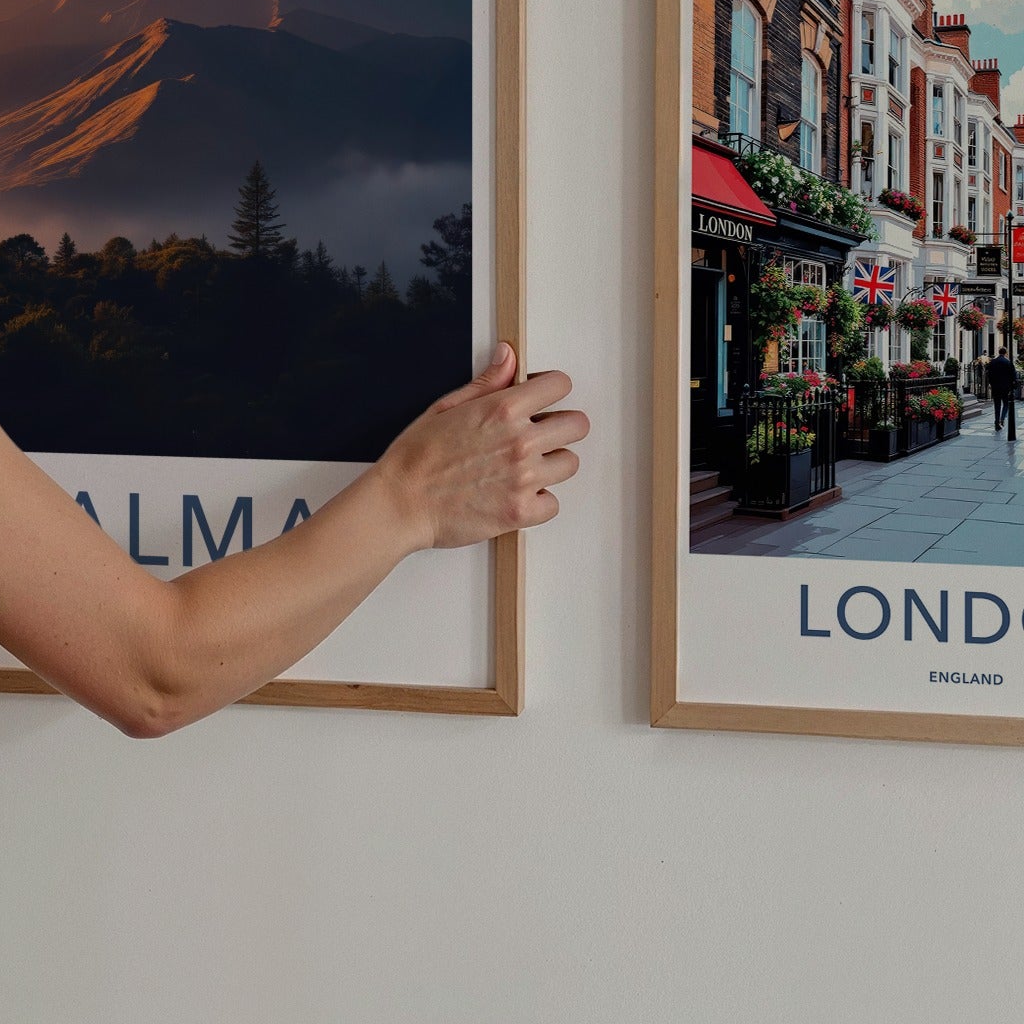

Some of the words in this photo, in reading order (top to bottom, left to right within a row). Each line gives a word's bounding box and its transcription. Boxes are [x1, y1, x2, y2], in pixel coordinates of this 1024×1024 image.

[698, 213, 753, 242] LONDON
[800, 584, 1024, 645] LOND
[929, 671, 1004, 686] ENGLAND
